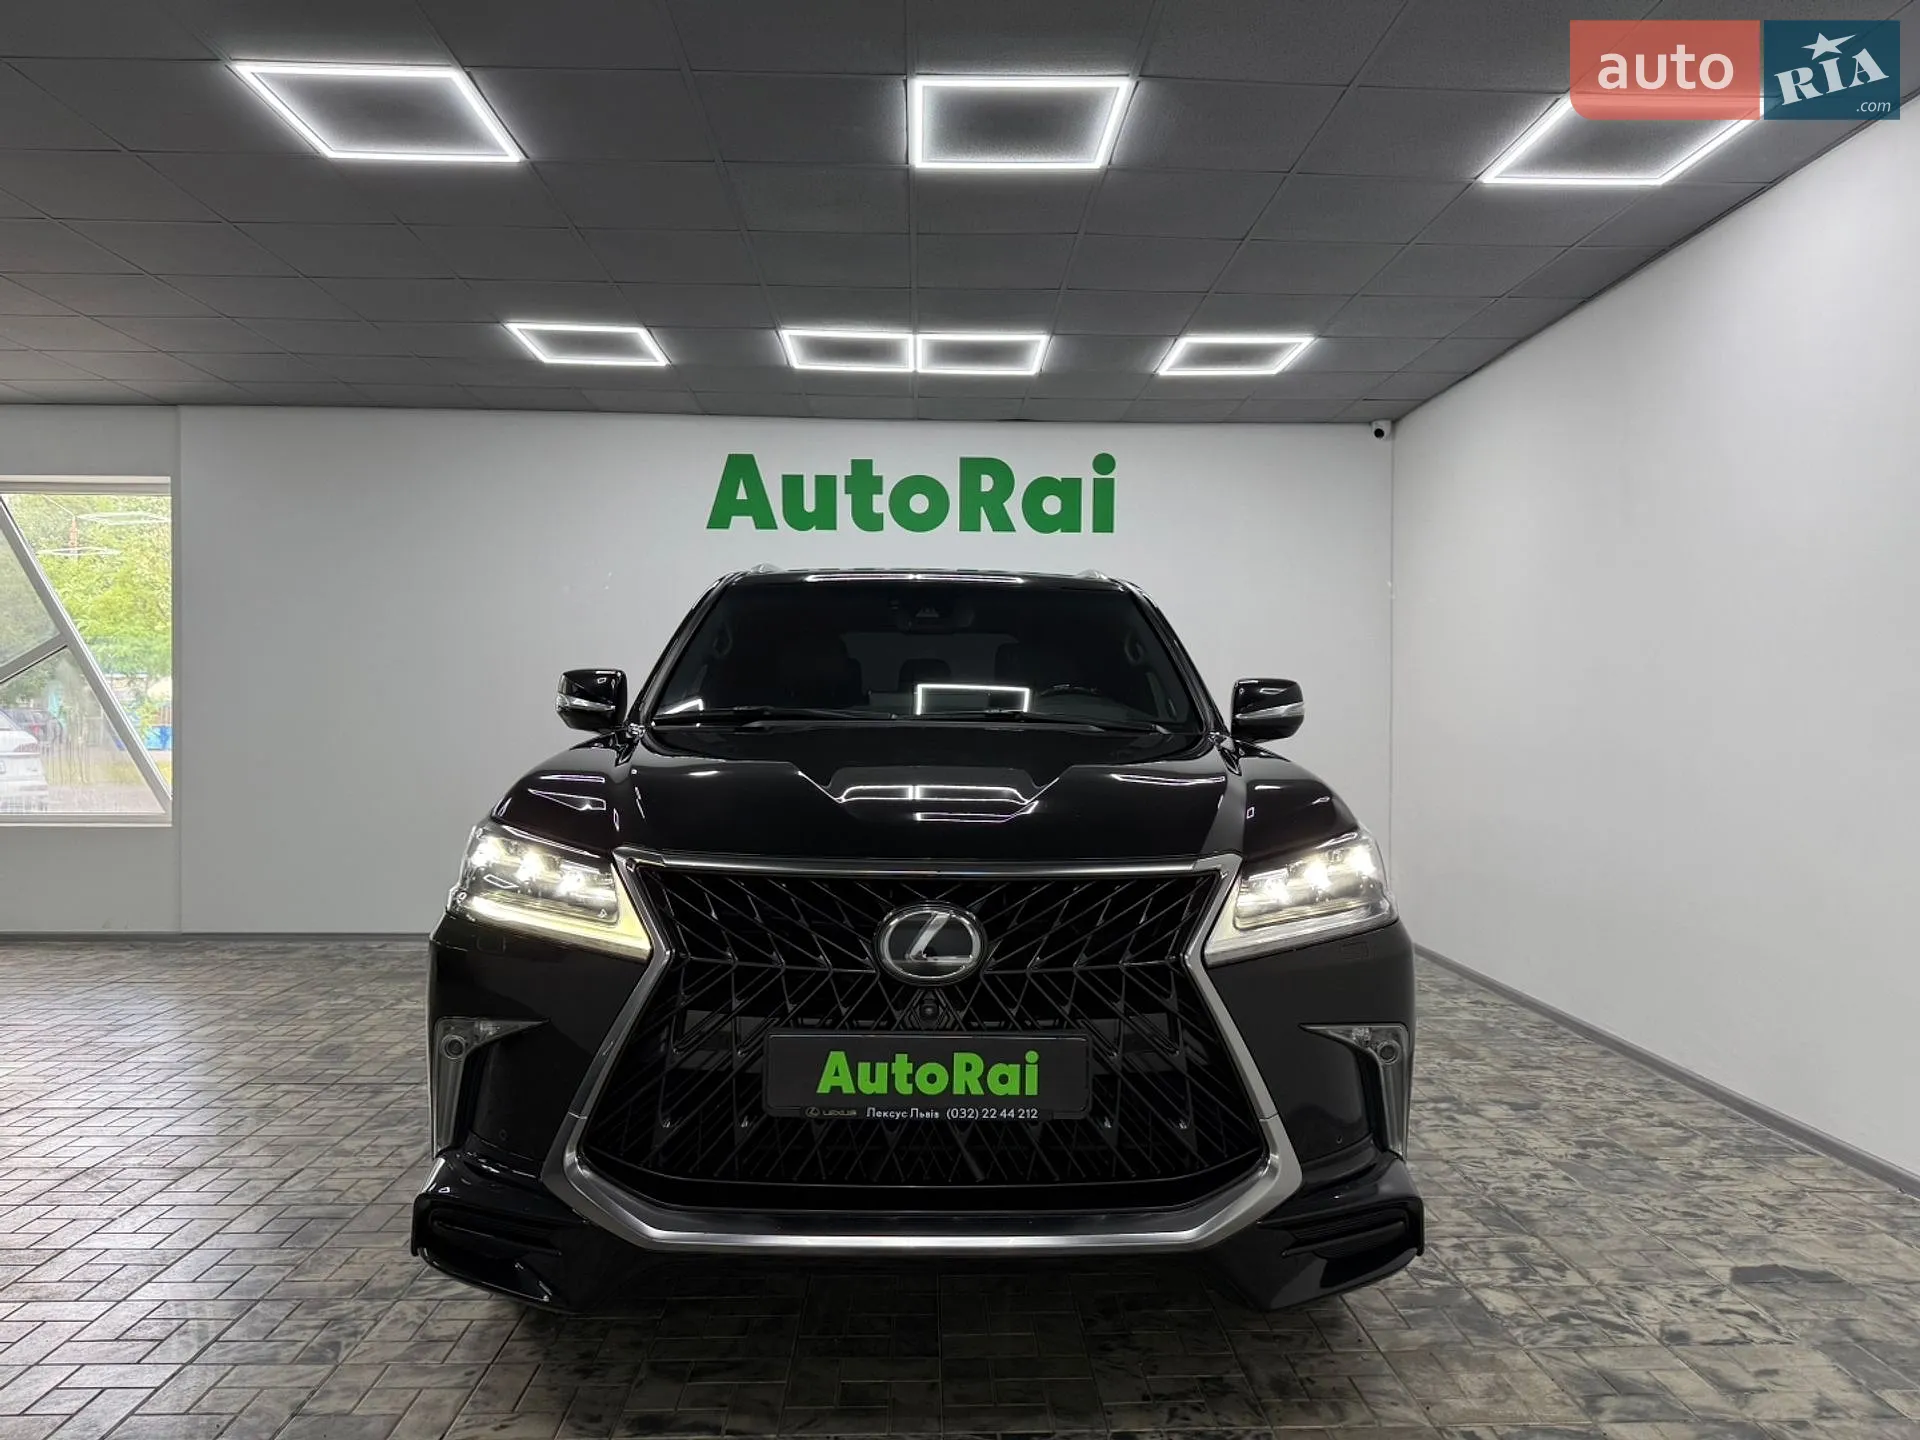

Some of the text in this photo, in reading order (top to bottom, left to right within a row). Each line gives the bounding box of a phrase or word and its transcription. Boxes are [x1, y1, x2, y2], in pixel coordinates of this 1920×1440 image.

[706, 452, 1117, 535] AutoRai
[816, 1050, 1039, 1097] AutoRai
[946, 1107, 979, 1120] (032)
[982, 1107, 998, 1119] 22
[1000, 1107, 1015, 1119] 44
[1018, 1107, 1039, 1119] 212
